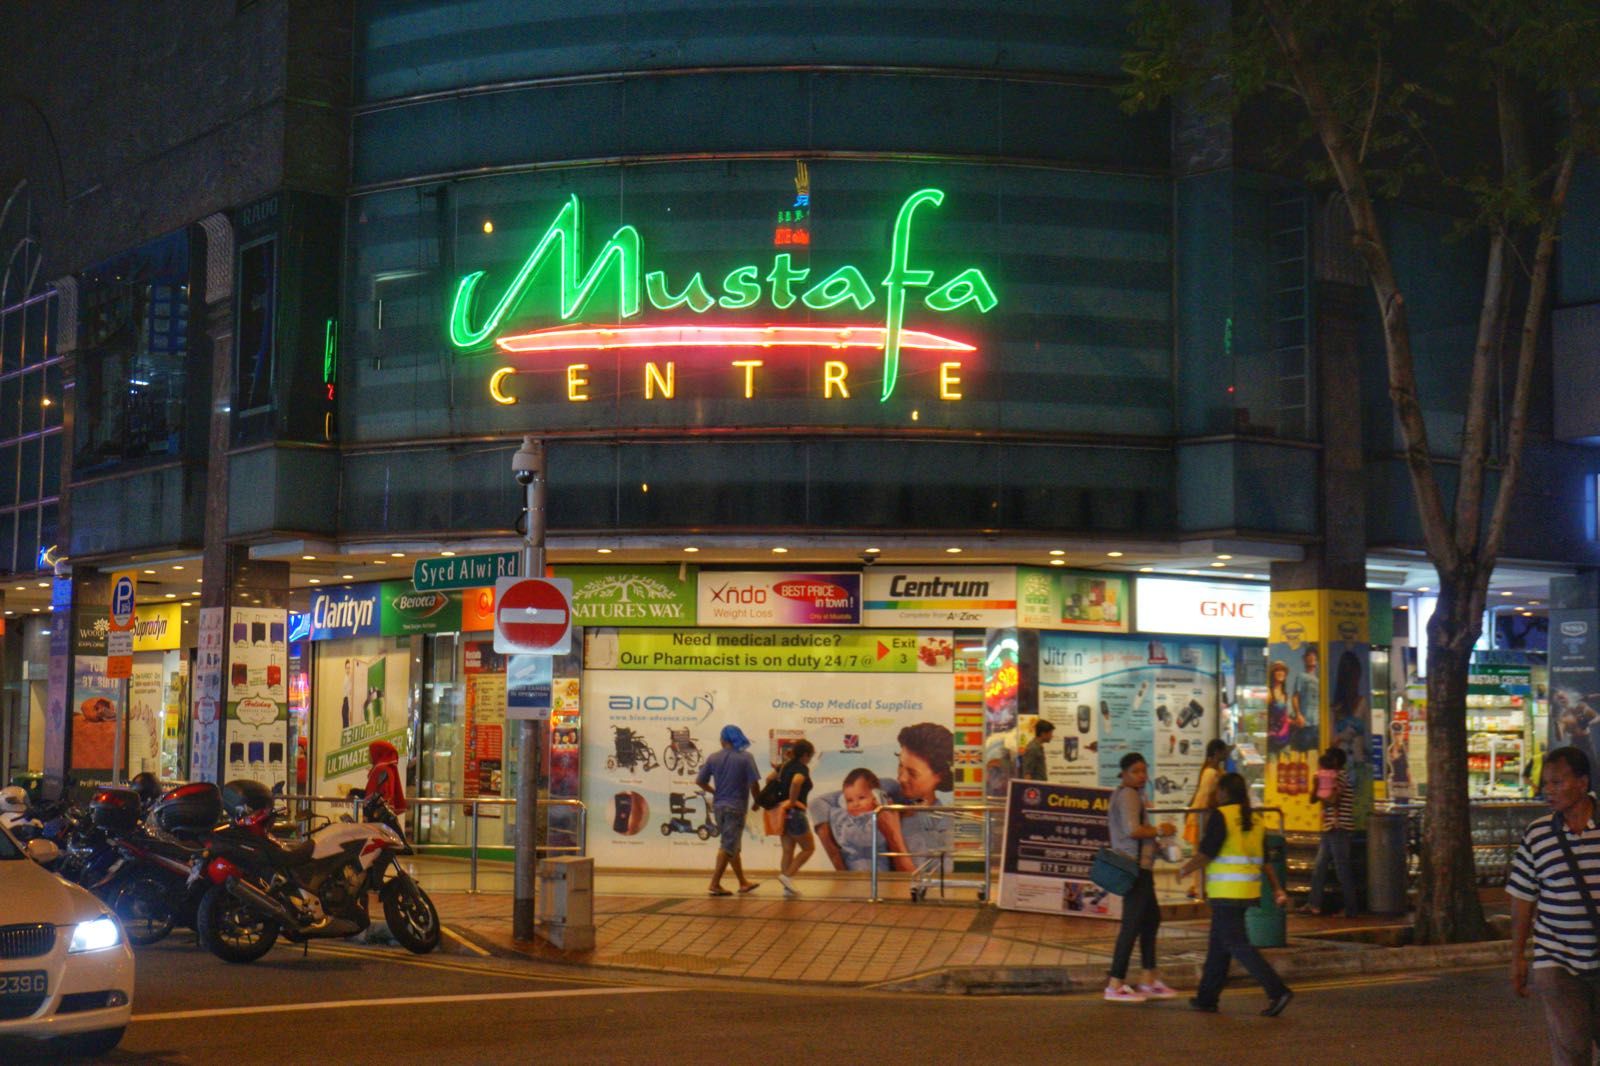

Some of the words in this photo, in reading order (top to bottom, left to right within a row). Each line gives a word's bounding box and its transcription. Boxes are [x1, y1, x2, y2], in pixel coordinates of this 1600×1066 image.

[449, 188, 998, 404] Mustafa
[489, 360, 964, 405] CENTRE
[421, 562, 454, 587] Syed
[459, 558, 492, 580] Alwi
[497, 555, 516, 577] Rd
[781, 585, 806, 597] BEST
[807, 585, 835, 597] PRICE
[889, 575, 989, 598] Centrum
[399, 595, 437, 610] Berocca
[571, 603, 647, 618] NATURE'S
[649, 603, 683, 618] WAY
[815, 597, 824, 608] in
[825, 597, 848, 609] town
[1200, 601, 1255, 618] GNC
[313, 595, 373, 635] Clarityn
[713, 608, 748, 620] Weight
[750, 608, 774, 618] Loss
[133, 615, 168, 642] Supradyn
[672, 633, 711, 646] Need
[716, 634, 777, 647] medical
[781, 634, 842, 647] advice?
[892, 638, 916, 649] Exit
[620, 652, 649, 665] Our
[653, 651, 740, 666] Pharmacist
[744, 654, 758, 666] is
[763, 656, 783, 667] on
[787, 655, 821, 669] duty
[824, 655, 858, 667] 24/7
[861, 656, 874, 668] @
[900, 653, 908, 664] 3
[1043, 647, 1083, 666] Jitrn
[1501, 675, 1529, 684] CENTRE
[609, 696, 698, 711] BION
[772, 699, 825, 711] One-Stop
[827, 700, 872, 710] Medical
[875, 701, 924, 712] Supplies
[327, 747, 369, 775] ULTIMATE
[1047, 794, 1089, 810] Crime
[0, 975, 45, 994] 239G
